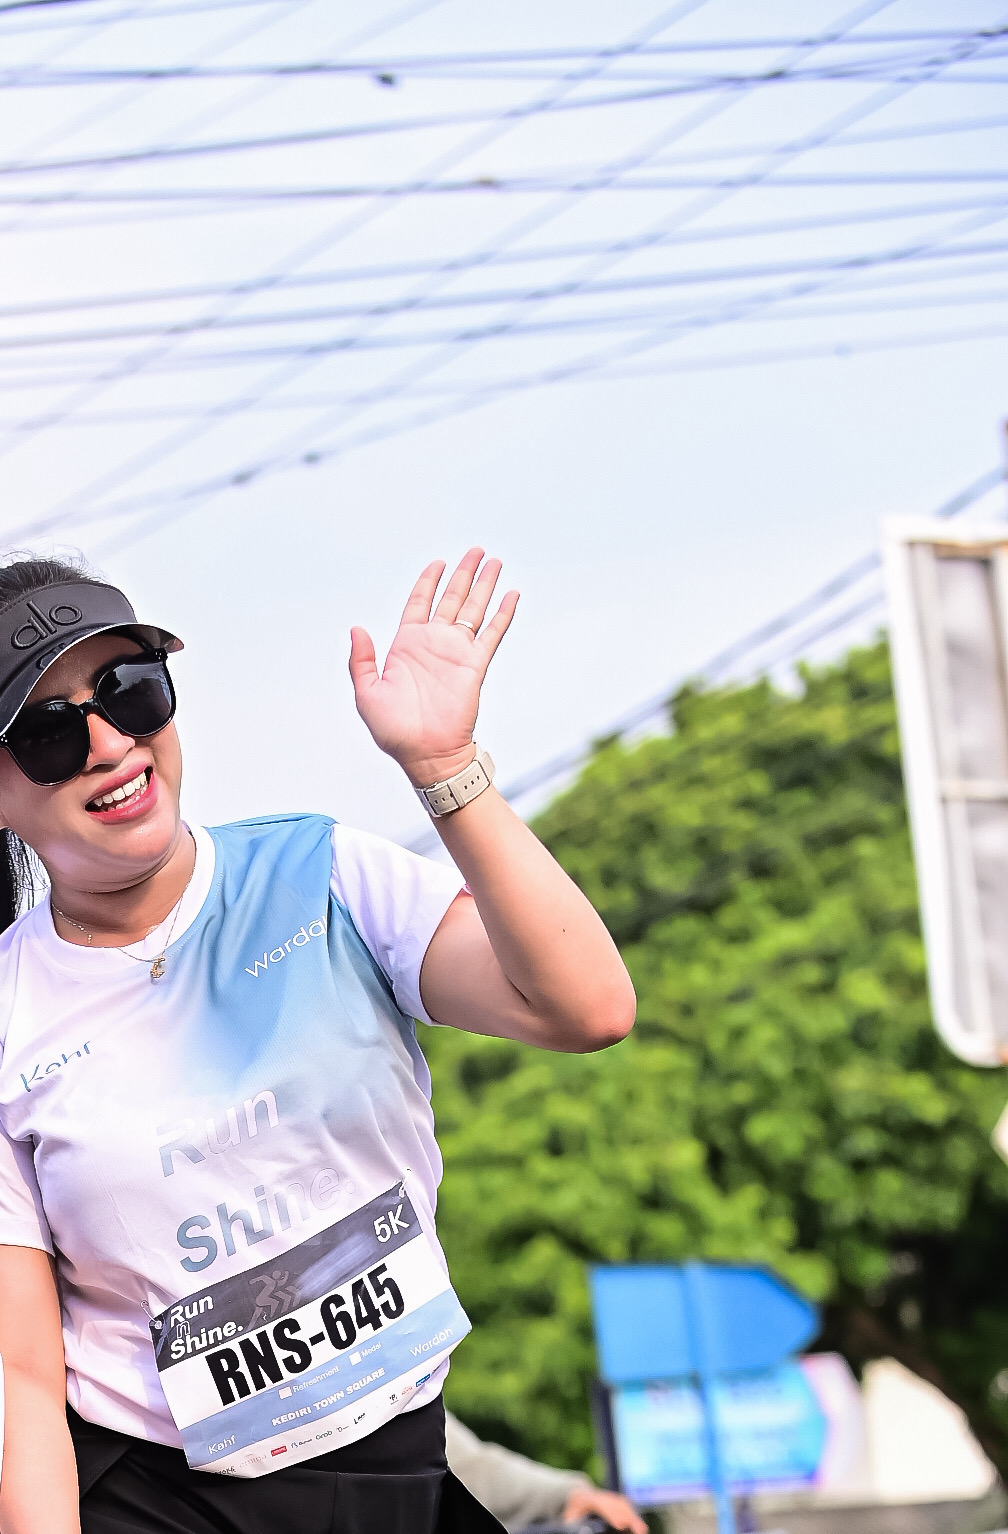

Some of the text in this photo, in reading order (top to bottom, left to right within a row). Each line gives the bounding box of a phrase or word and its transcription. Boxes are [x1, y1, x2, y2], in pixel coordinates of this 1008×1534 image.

[11, 600, 83, 650] alo
[156, 1089, 280, 1178] Run
[373, 1203, 410, 1243] 5K
[170, 1294, 214, 1328] Run
[205, 1262, 405, 1407] RNS-645
[170, 1318, 244, 1360] Shine.
[292, 1341, 382, 1393] Refreshment Medal
[271, 1406, 312, 1427] KEDIRI
[313, 1389, 345, 1412] TOWN
[346, 1367, 386, 1396] SQUARE
[207, 1434, 236, 1455] Kahf
